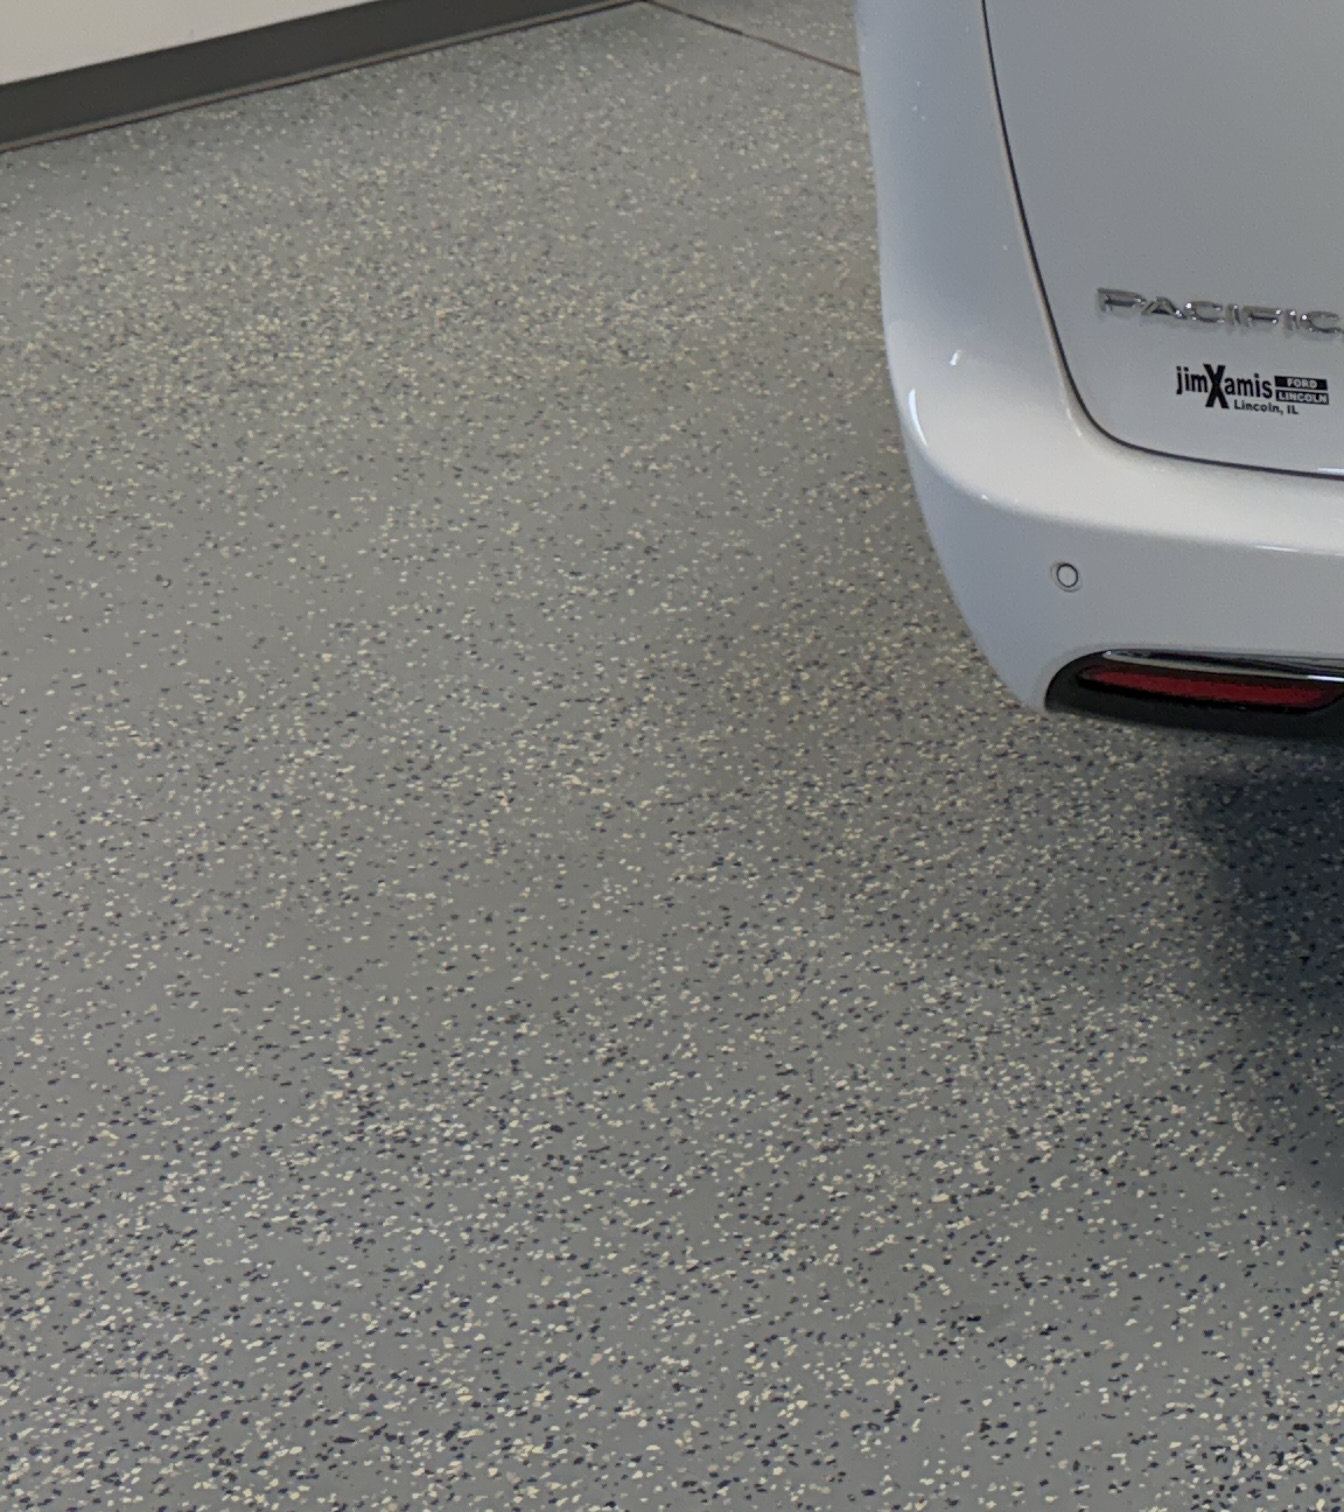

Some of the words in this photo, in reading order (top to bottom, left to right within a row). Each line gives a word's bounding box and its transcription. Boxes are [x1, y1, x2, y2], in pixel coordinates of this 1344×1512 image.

[1286, 377, 1318, 389] FORD
[1278, 391, 1328, 404] LINCOLN
[1234, 399, 1284, 415] Lincoln,
[1287, 405, 1299, 415] IL
